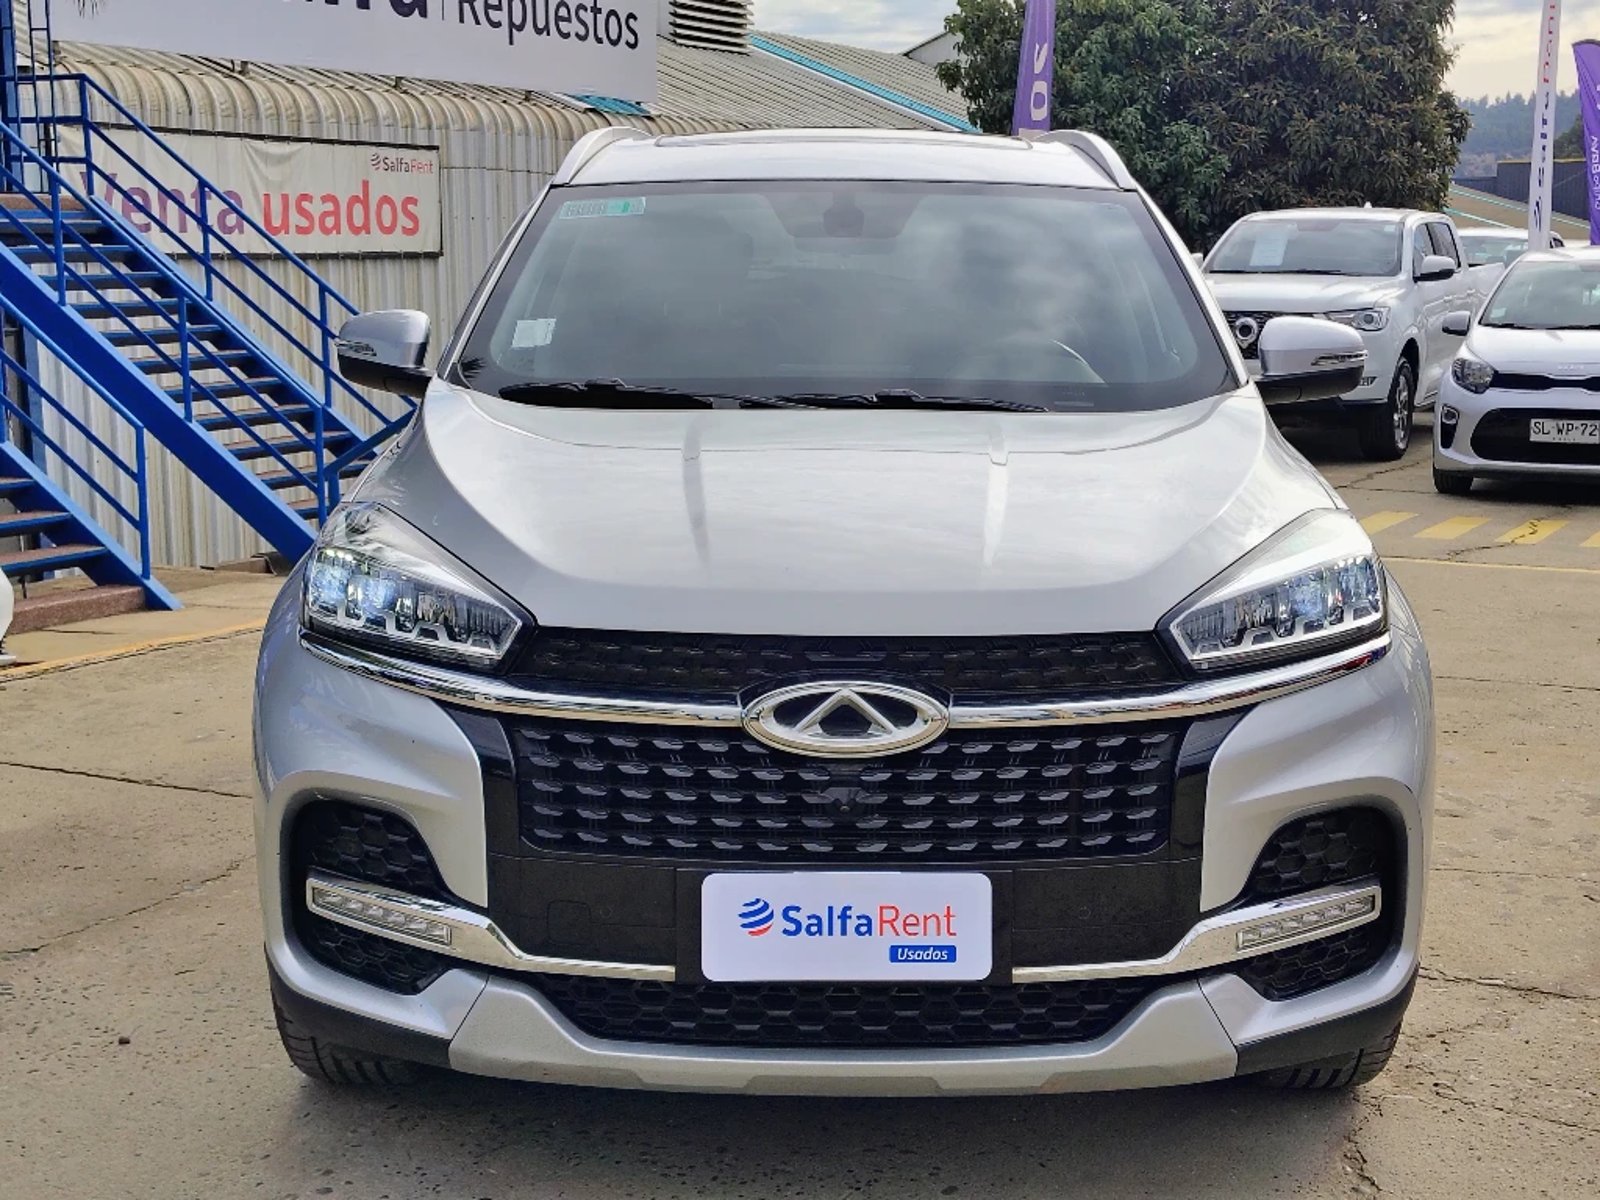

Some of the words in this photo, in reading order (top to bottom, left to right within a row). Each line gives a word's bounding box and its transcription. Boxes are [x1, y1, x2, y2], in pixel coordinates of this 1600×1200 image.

[382, 156, 434, 174] SalfaRent
[262, 179, 421, 237] usados
[781, 904, 958, 938] SalfaRent
[897, 947, 949, 961] Usados
